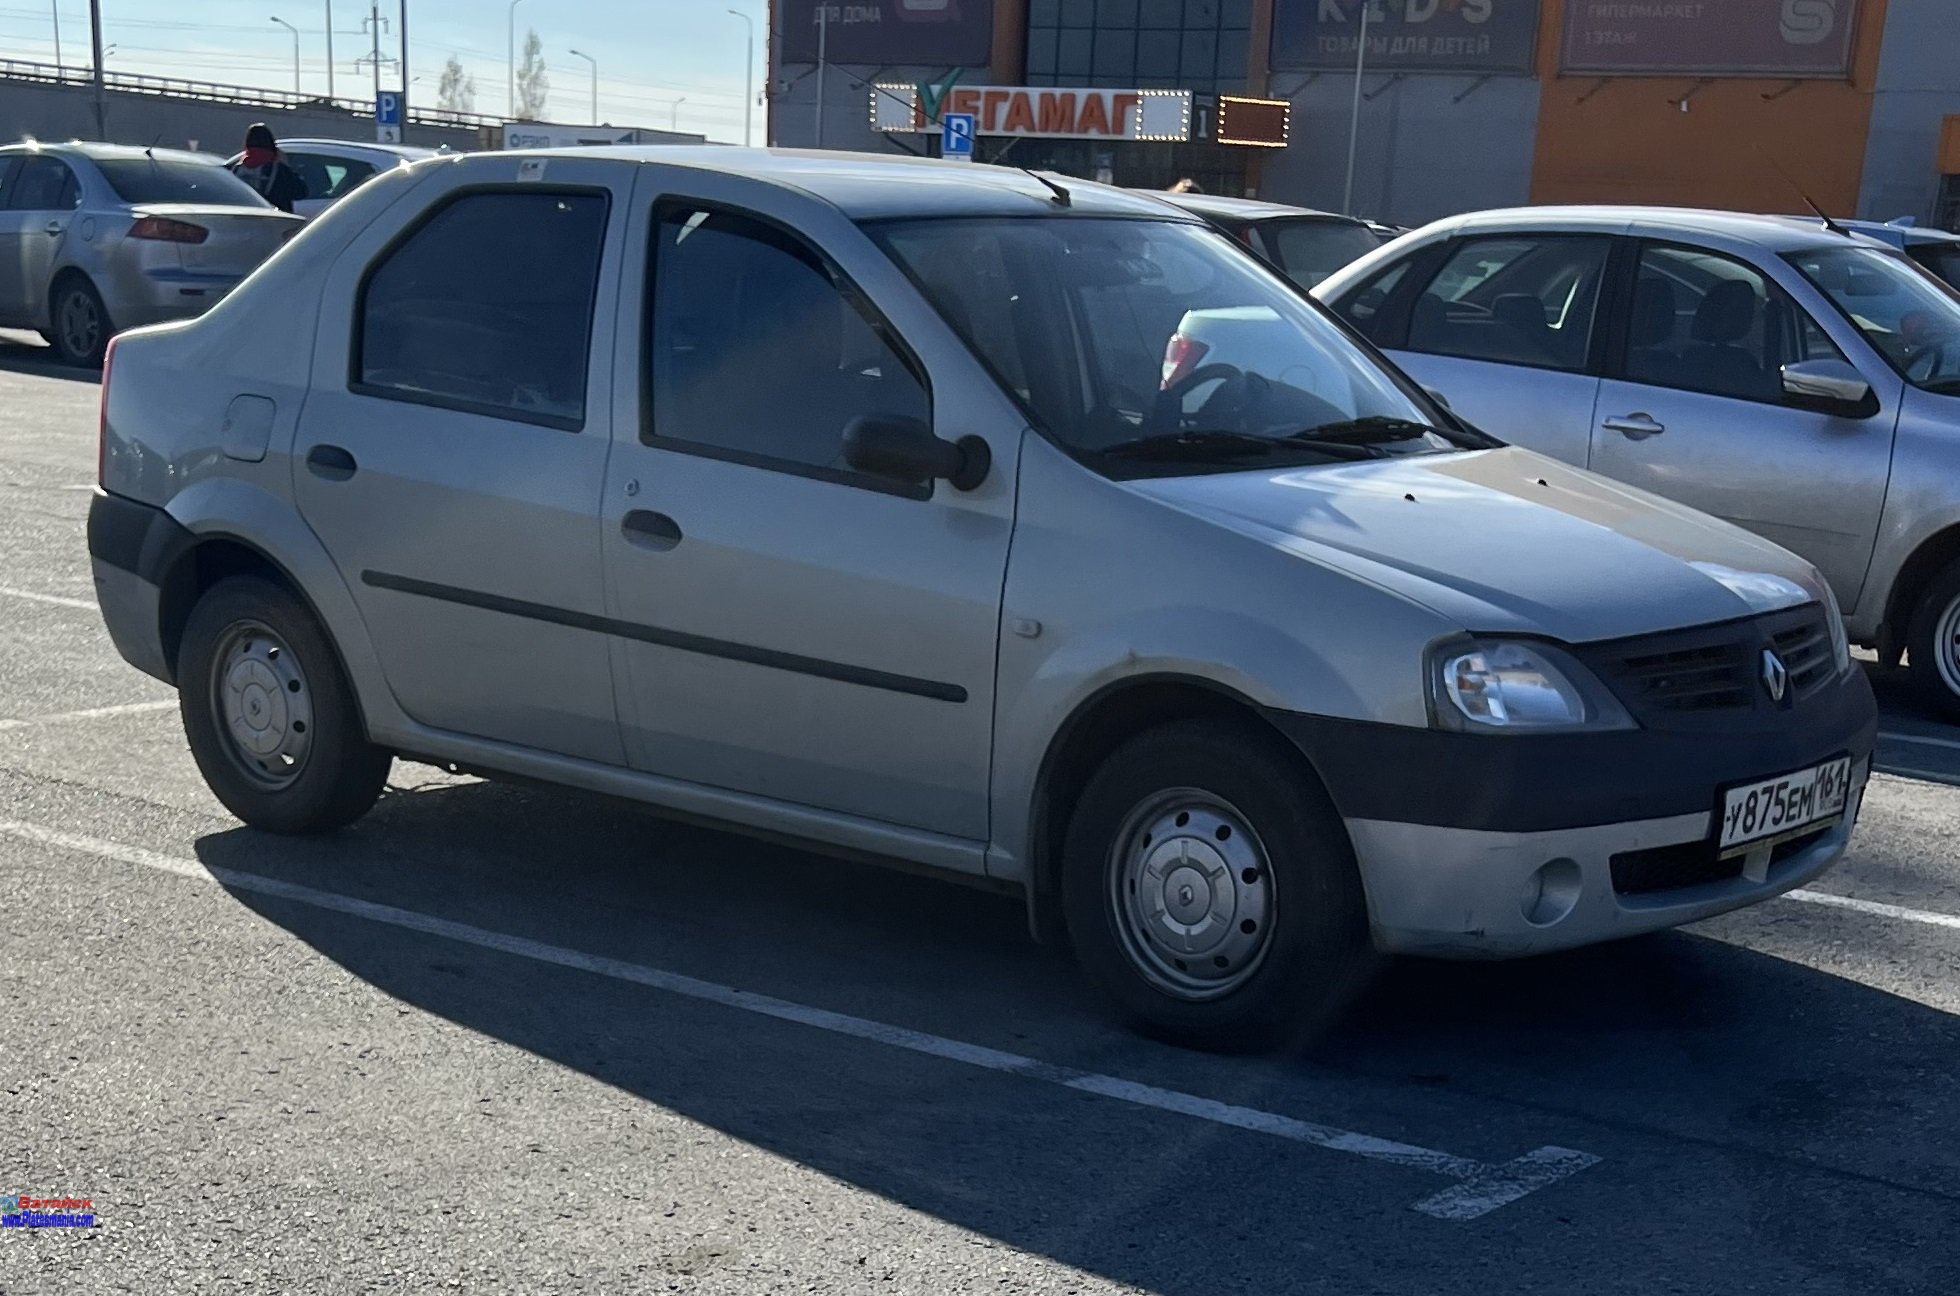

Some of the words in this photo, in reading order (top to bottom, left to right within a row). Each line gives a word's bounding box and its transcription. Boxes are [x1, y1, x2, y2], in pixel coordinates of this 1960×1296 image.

[843, 6, 881, 25] ДОМА
[1588, 4, 1704, 19] ГИПЕРМАРКЕТ
[1318, 35, 1389, 52] ТОВАРЫ
[1390, 35, 1428, 55] ДЛЯ
[1430, 33, 1490, 55] ДЕТЕЙ
[381, 95, 395, 121] P
[915, 72, 1138, 135] МЕГАМАГ
[951, 118, 968, 149] P
[1730, 781, 1815, 839] У875ЕМ
[1817, 760, 1845, 799] 161
